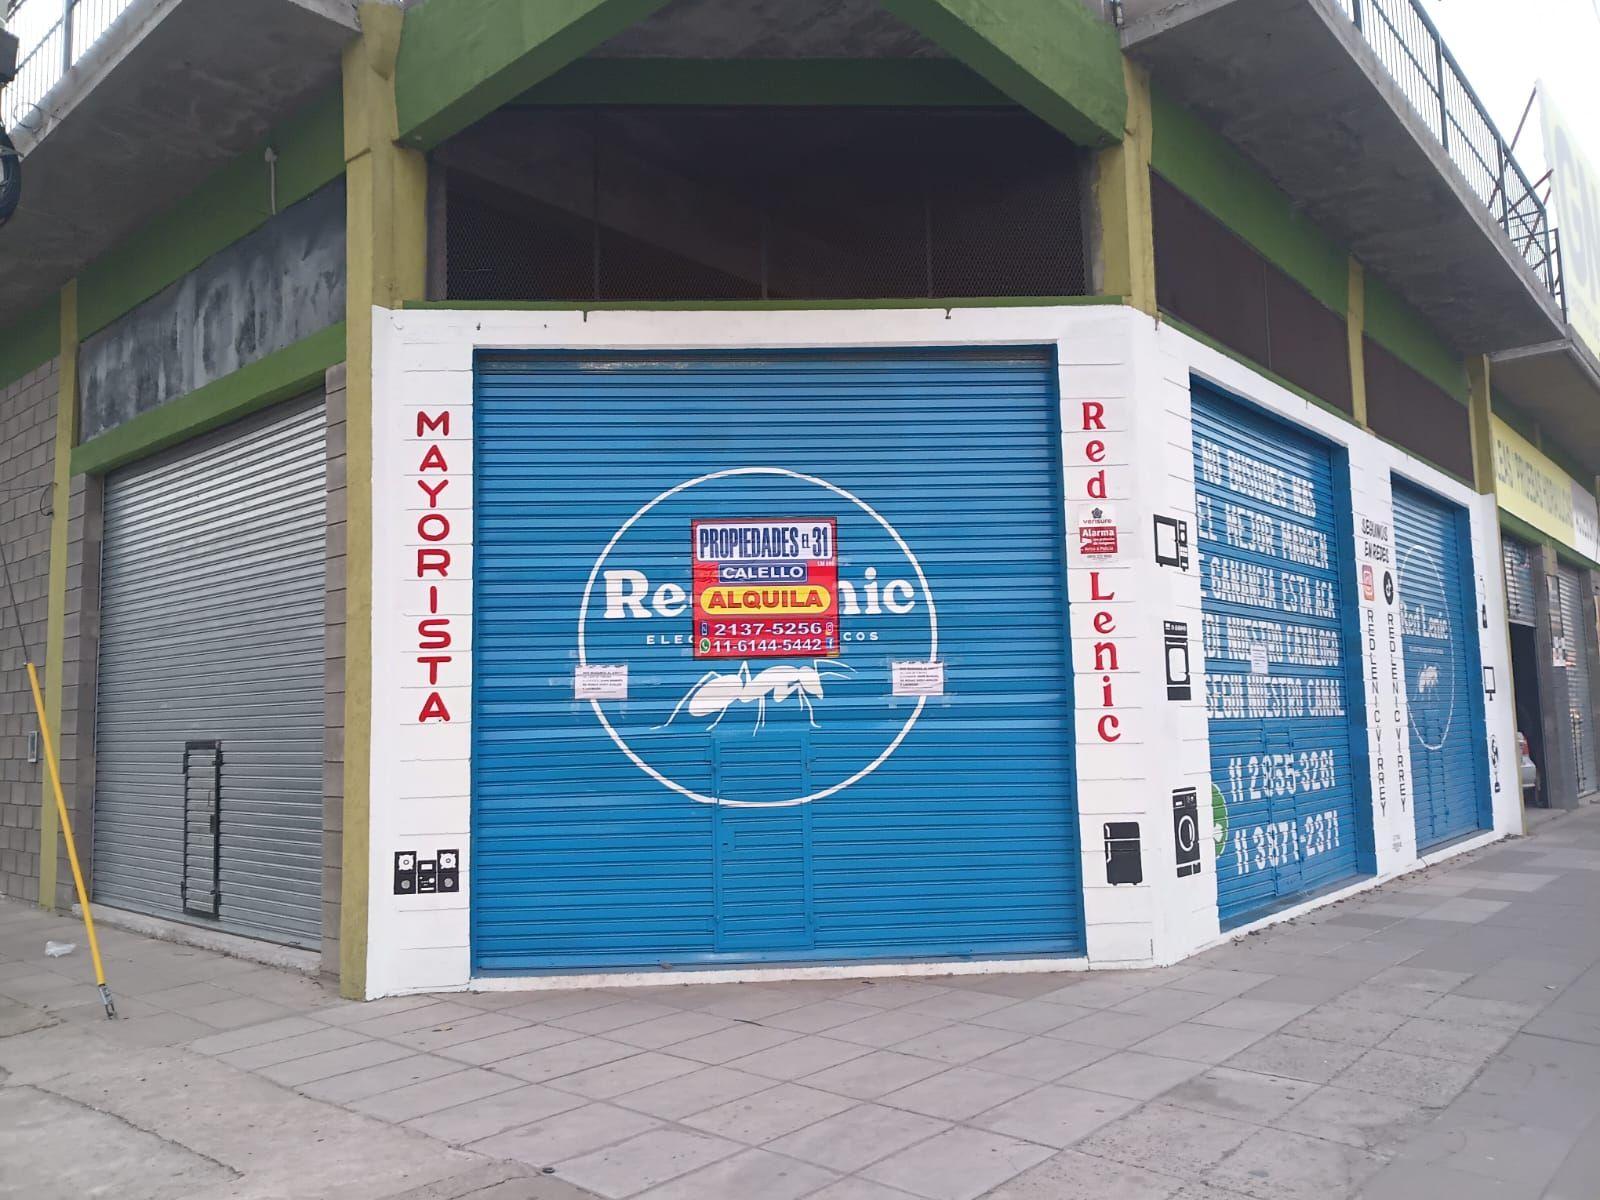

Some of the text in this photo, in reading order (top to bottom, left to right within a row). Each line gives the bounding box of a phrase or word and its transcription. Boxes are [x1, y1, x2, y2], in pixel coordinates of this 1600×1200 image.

[1082, 401, 1107, 499] Red
[1201, 439, 1222, 485] NO
[699, 526, 829, 559] PROPIEDADES EL 31
[1082, 529, 1115, 537] Alarma
[1196, 493, 1328, 569] EL MEJOR MARGEN
[417, 410, 452, 723] MAYORISTA
[722, 566, 804, 579] CALELLO
[1211, 556, 1276, 610] GANANCIA
[1281, 572, 1313, 615] ESTA
[1315, 579, 1336, 618] ACA
[708, 590, 824, 609] ALQUILA
[713, 639, 822, 652] 11-6144-5442
[714, 623, 822, 636] 2137-5256
[1286, 625, 1339, 667] CATALOGO
[1090, 571, 1121, 743] Lenic
[1247, 675, 1304, 718] NUESTRO
[1307, 678, 1345, 717] CANAL
[1228, 757, 1244, 802] 11
[1234, 809, 1339, 875] 11 3871-2371
